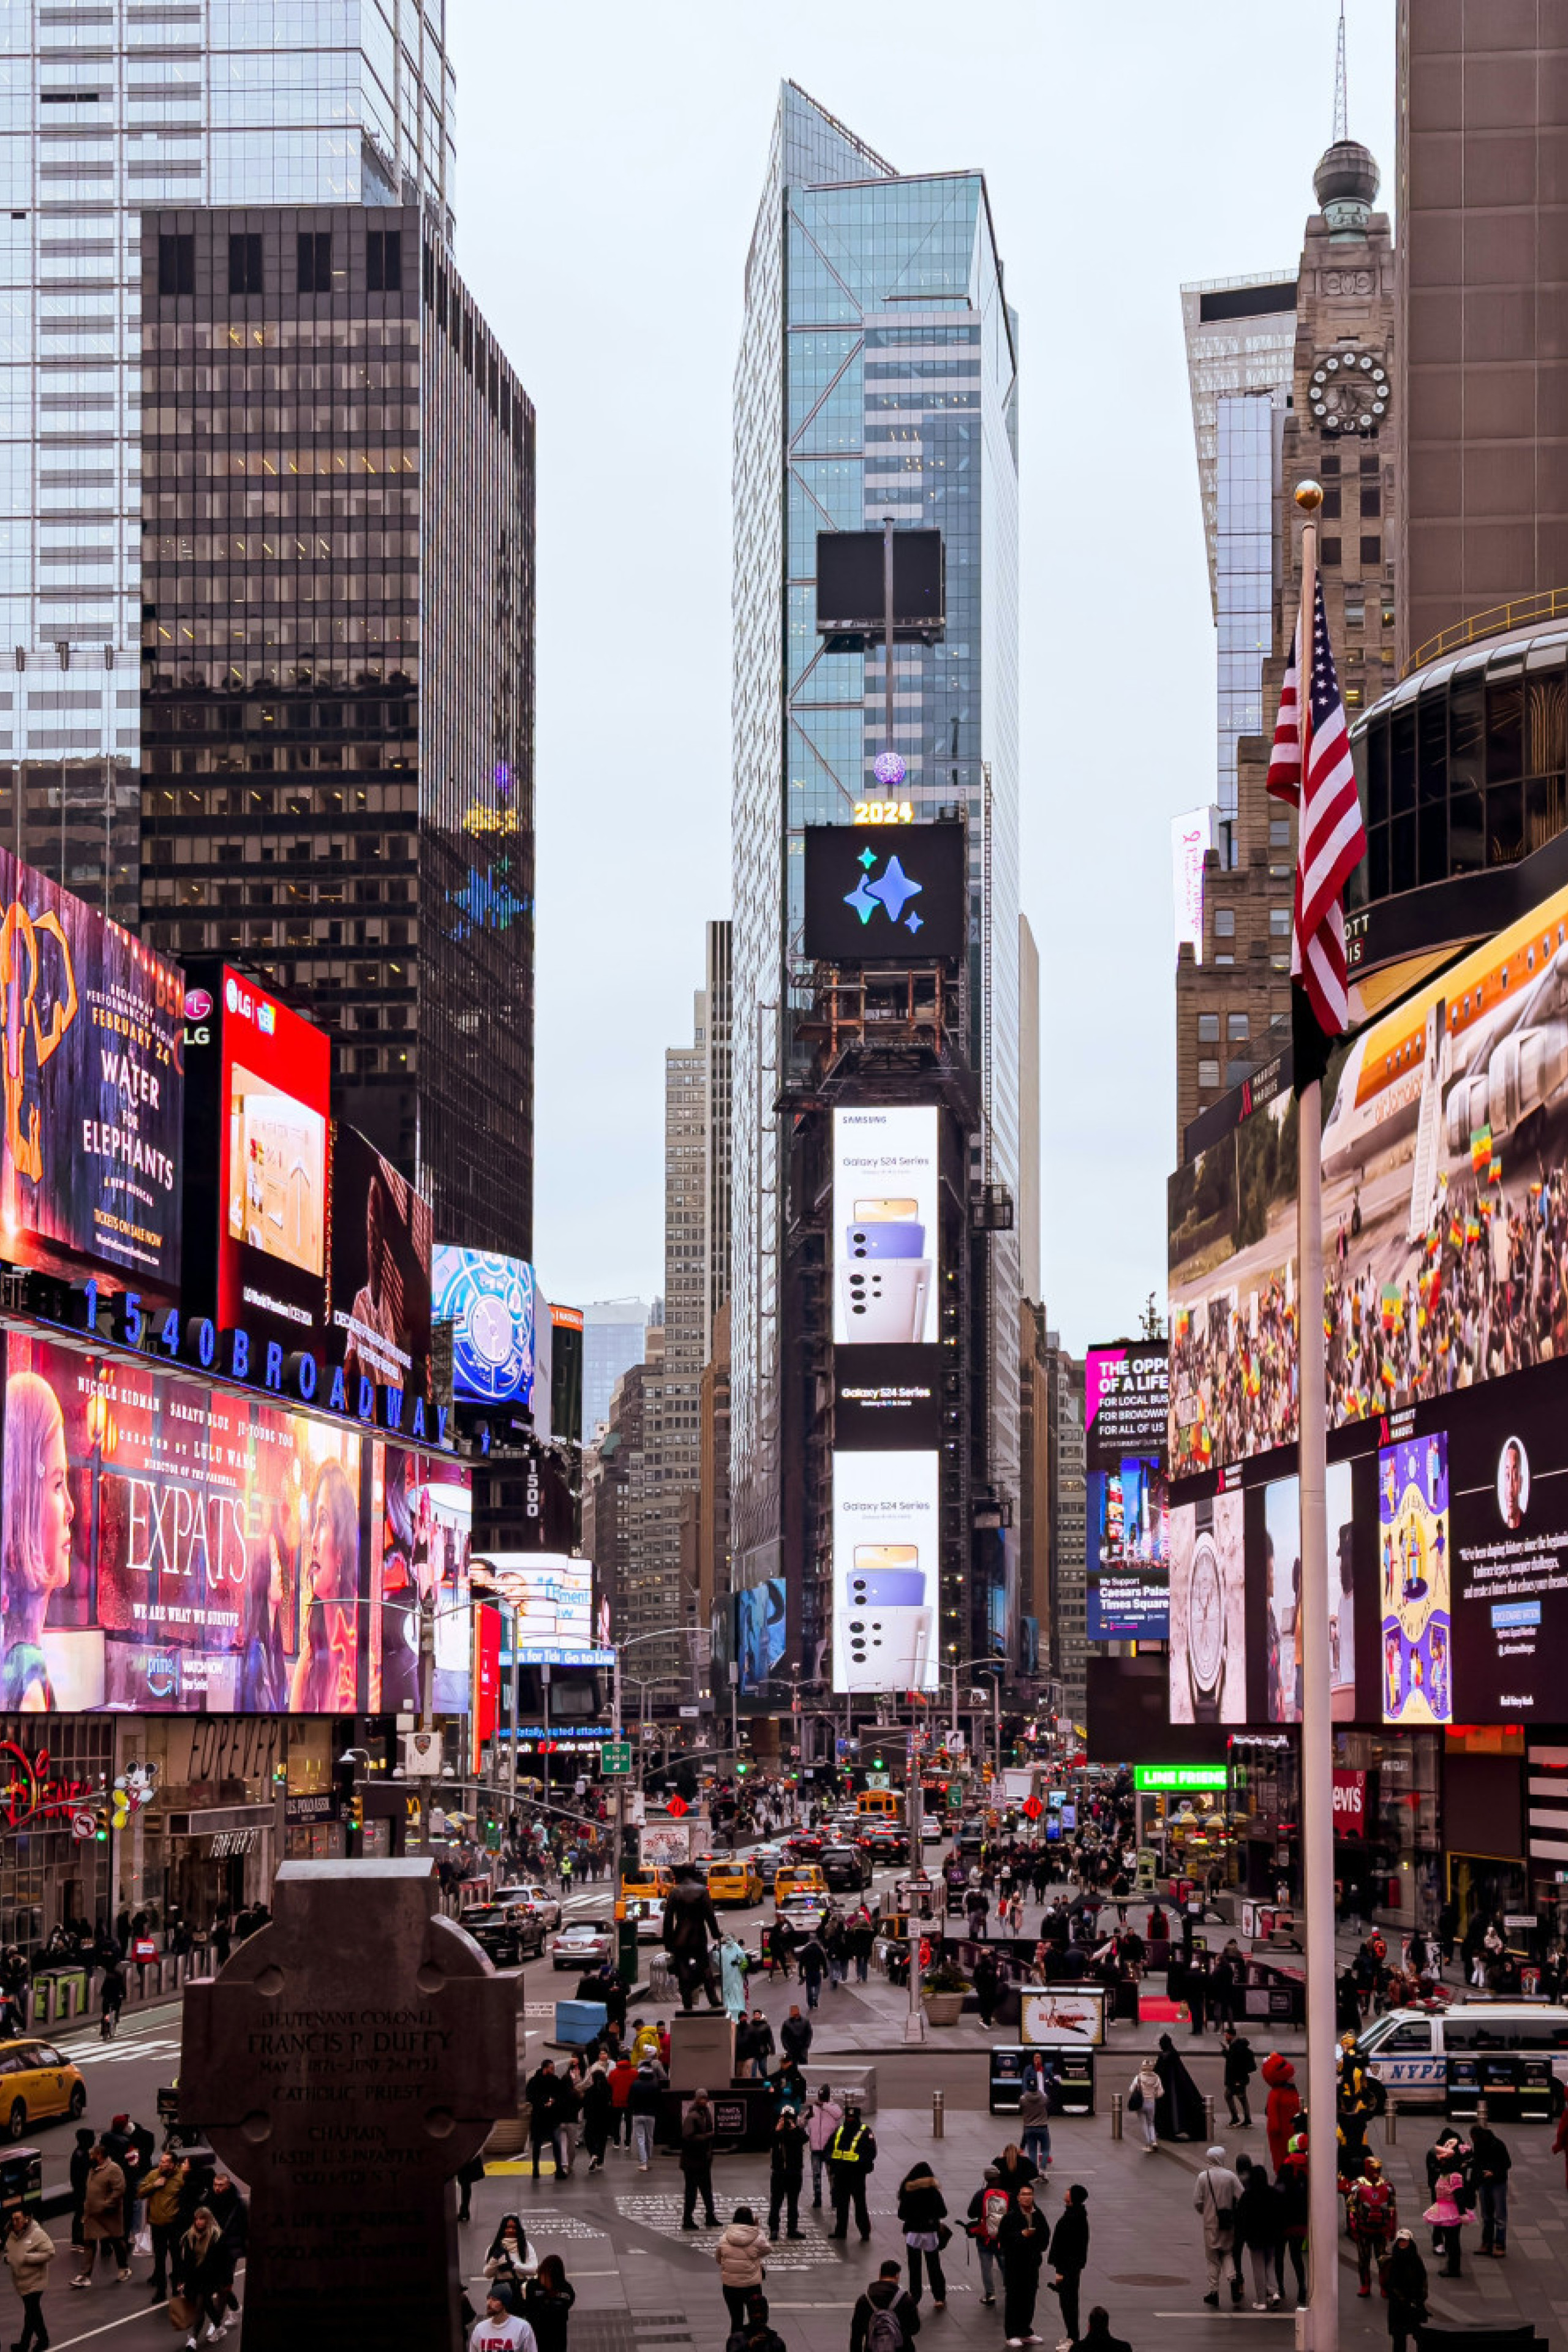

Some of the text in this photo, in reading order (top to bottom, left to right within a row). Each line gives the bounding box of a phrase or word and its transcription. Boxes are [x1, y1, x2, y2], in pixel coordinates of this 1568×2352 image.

[854, 801, 913, 824] 2024
[238, 990, 252, 1019] LG
[92, 1007, 170, 1066] FEBRUARY 24
[184, 1027, 211, 1046] LG
[100, 1049, 160, 1111] WATER
[123, 1109, 140, 1131] FOR
[83, 1119, 173, 1191] ELEPHANTS
[843, 1155, 929, 1168] Galaxy S24 Series
[94, 1208, 119, 1231] TICKETS
[119, 1219, 130, 1235] ON
[145, 1229, 163, 1248] NOW
[85, 1278, 216, 1368] 1540
[233, 1327, 449, 1446] BROADWAY
[1099, 1360, 1129, 1377] THE
[842, 1386, 931, 1400] Galaxy S24 Series
[1099, 1374, 1168, 1393] OF A LIFE
[78, 1376, 117, 1401] NICOLE
[120, 1388, 160, 1412] KIDMAN
[170, 1401, 205, 1425] SARAYU
[1099, 1396, 1117, 1408] FOR
[1118, 1395, 1148, 1406] LOCAL
[1099, 1411, 1117, 1422] FOR
[1099, 1422, 1165, 1435] FOR ALL OF US
[194, 1440, 222, 1464] LULU
[228, 1449, 257, 1471] WANG
[526, 1458, 539, 1517] 1500
[843, 1500, 930, 1513] Galaxy S24 Series
[126, 1478, 250, 1589] EXPATS
[1112, 1577, 1140, 1587] Support
[1099, 1587, 1142, 1598] Caesars
[133, 1604, 148, 1620] WE
[148, 1605, 166, 1620] ARE
[167, 1607, 192, 1623] WHAT
[192, 1608, 206, 1624] WE
[1099, 1598, 1170, 1611] Times Square
[147, 1653, 173, 1678] prime
[1144, 1770, 1177, 1785] LINE
[209, 1830, 247, 1858] FOREVER
[262, 2009, 434, 2028] LIEUTENANT COLONEL
[247, 2030, 343, 2054] FRANCIS
[374, 2028, 456, 2052] DUFFY
[1390, 2064, 1447, 2079] NYPD
[272, 2084, 424, 2102] CATHOLIC PRIEST
[480, 2338, 513, 2351] USA
